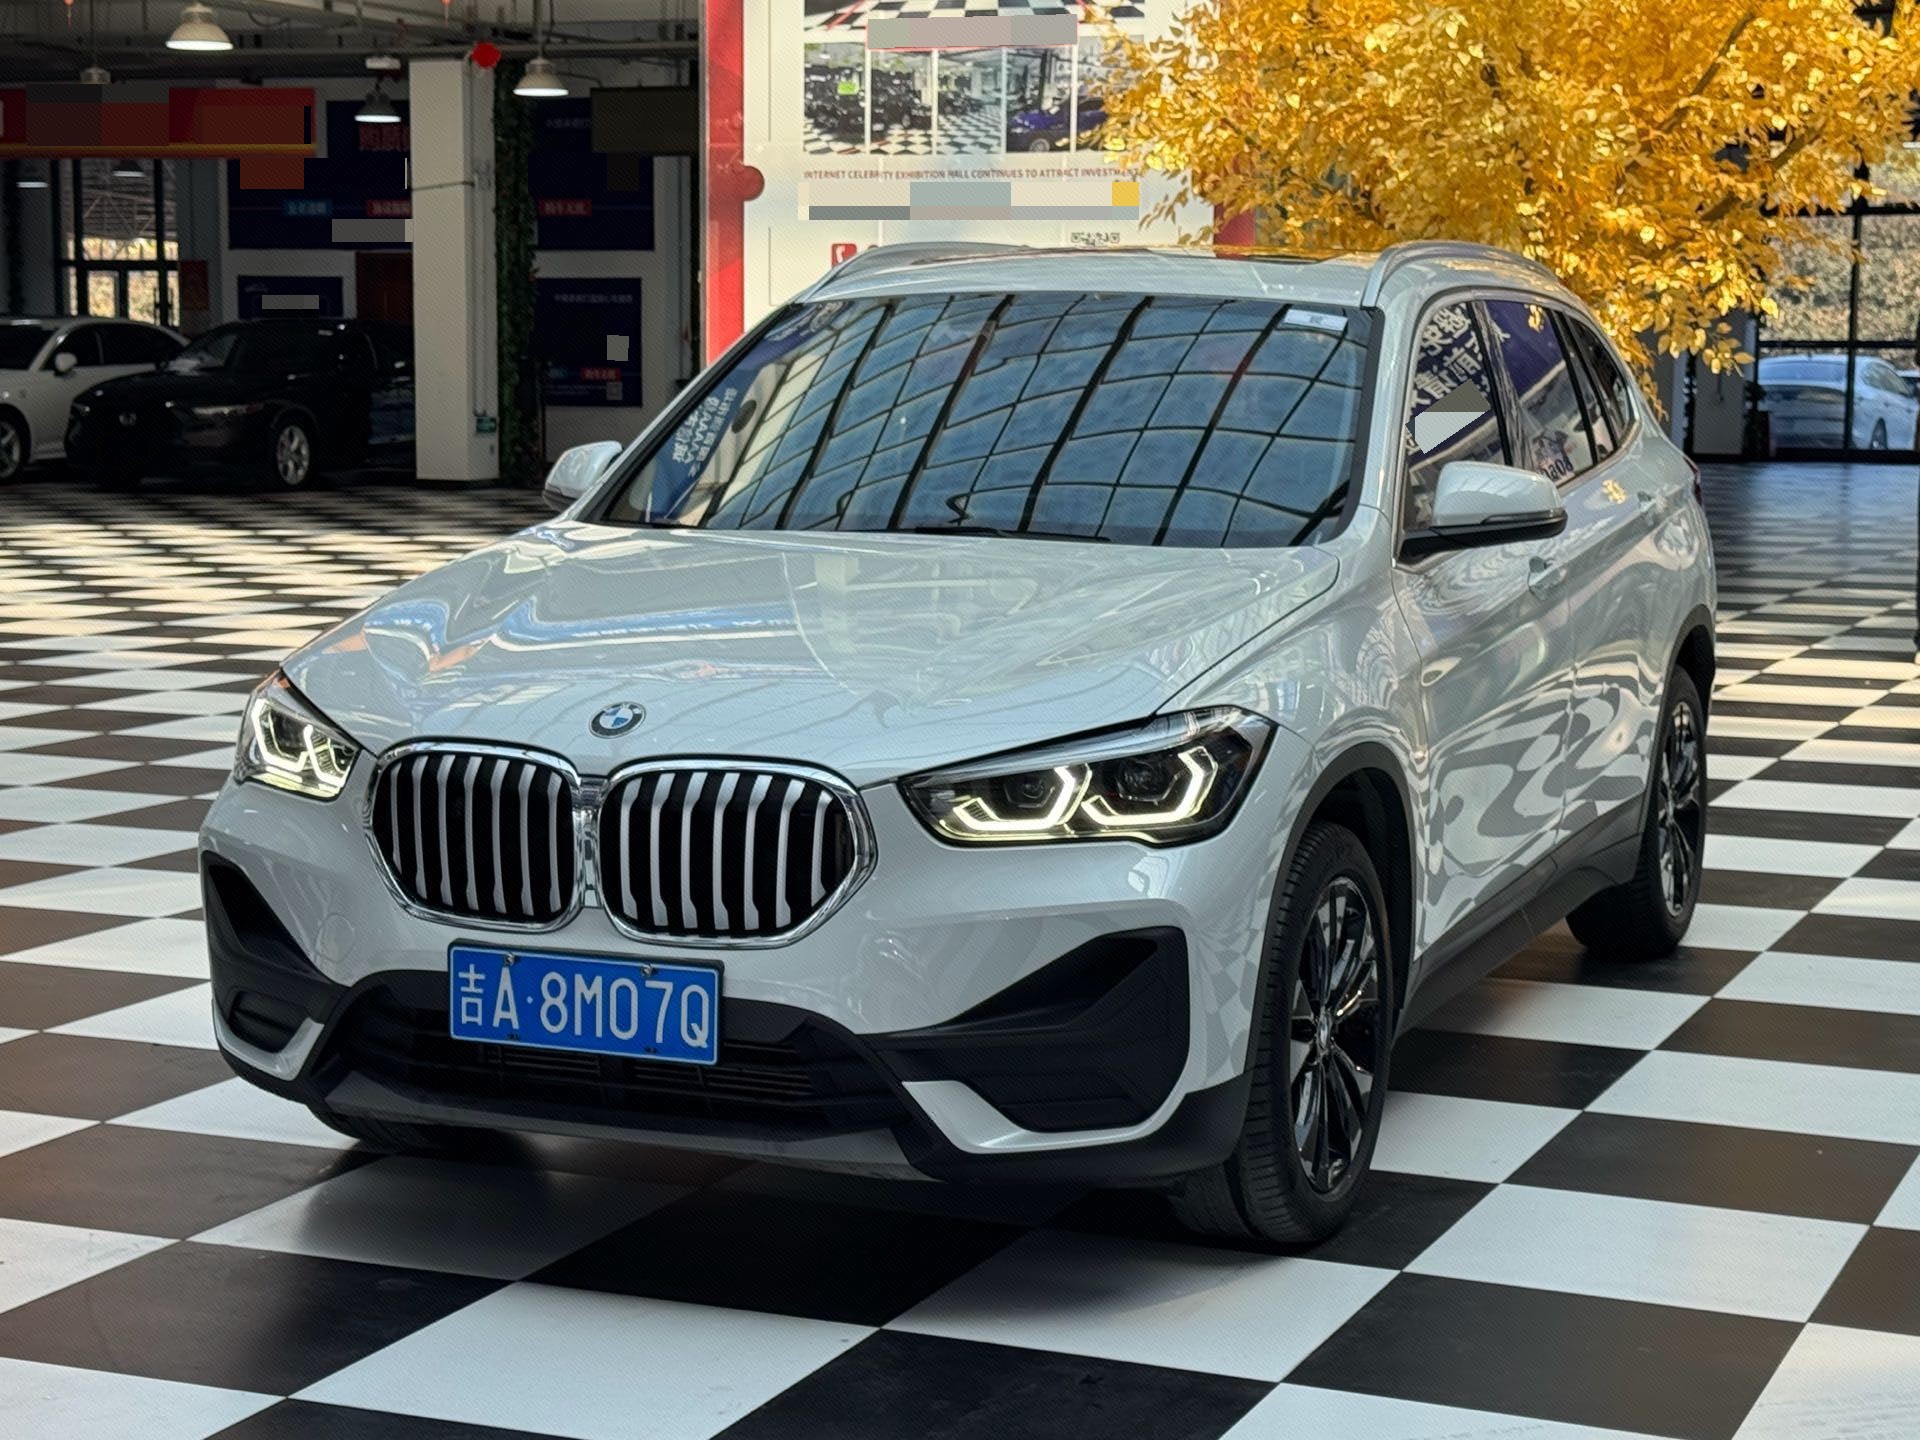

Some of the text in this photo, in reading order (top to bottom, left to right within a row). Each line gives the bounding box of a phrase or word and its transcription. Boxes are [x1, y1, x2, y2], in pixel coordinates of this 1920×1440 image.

[803, 170, 846, 180] INTERNET
[848, 170, 893, 180] CELEBRTY
[895, 170, 946, 180] EXHIBITION
[948, 169, 970, 179] HALL
[971, 169, 1023, 179] CONTINUES
[1025, 169, 1038, 178] TO
[1039, 168, 1079, 178] ATTRACT
[457, 963, 710, 1049] 吉A·8M07Q
